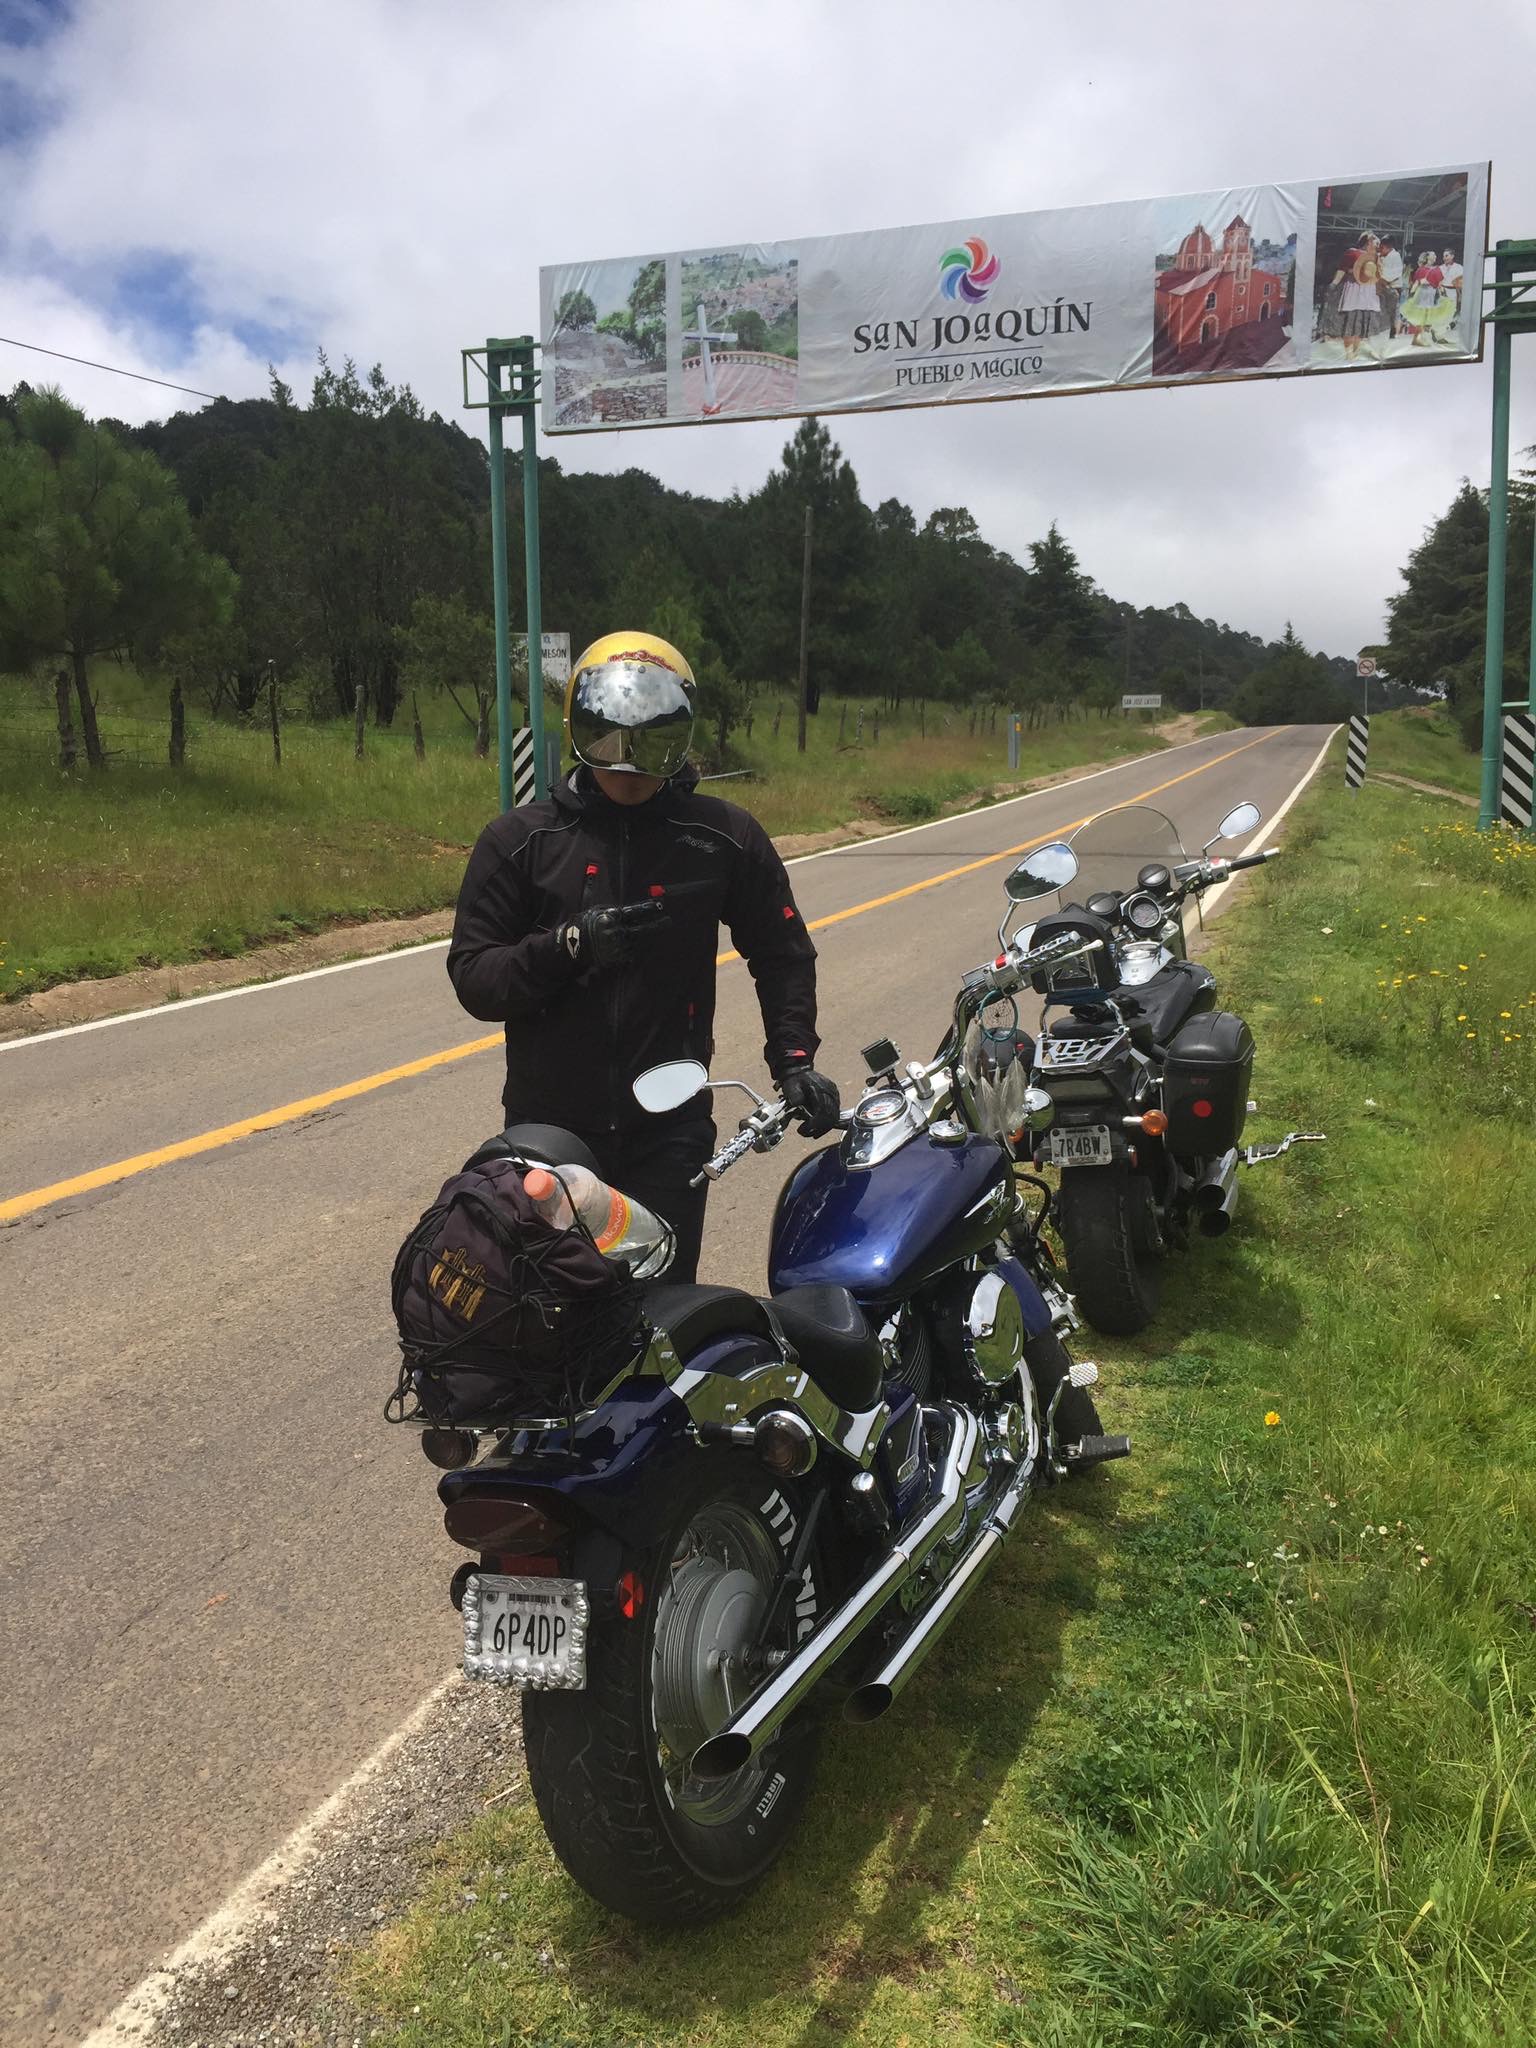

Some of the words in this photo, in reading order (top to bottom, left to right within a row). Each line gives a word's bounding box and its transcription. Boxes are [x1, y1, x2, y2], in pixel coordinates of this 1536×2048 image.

[1058, 1135, 1101, 1158] 7R4BW
[493, 1612, 566, 1659] 6P4DP
[756, 1772, 786, 1818] PIRELLI
